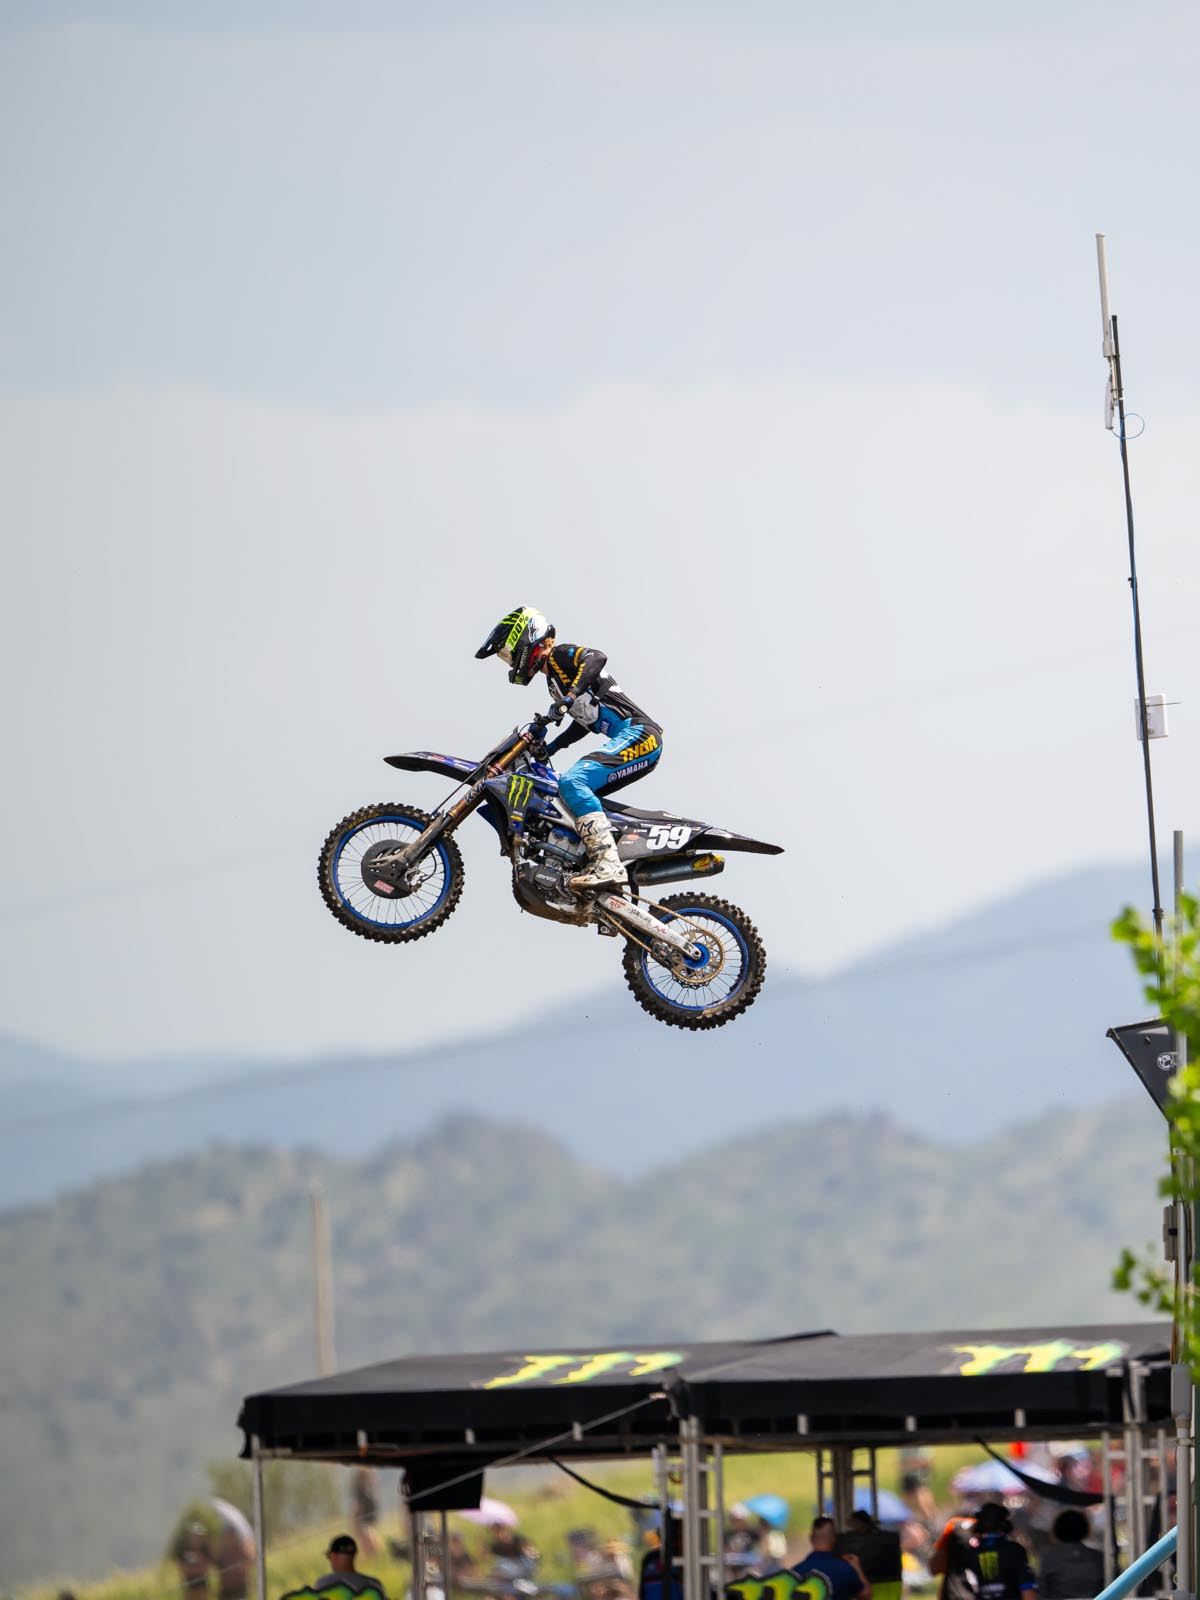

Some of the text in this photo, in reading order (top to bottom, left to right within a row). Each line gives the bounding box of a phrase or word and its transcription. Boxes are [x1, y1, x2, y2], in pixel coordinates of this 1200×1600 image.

[619, 734, 658, 763] THOR
[616, 760, 649, 779] YAMAHA
[646, 825, 692, 850] 59
